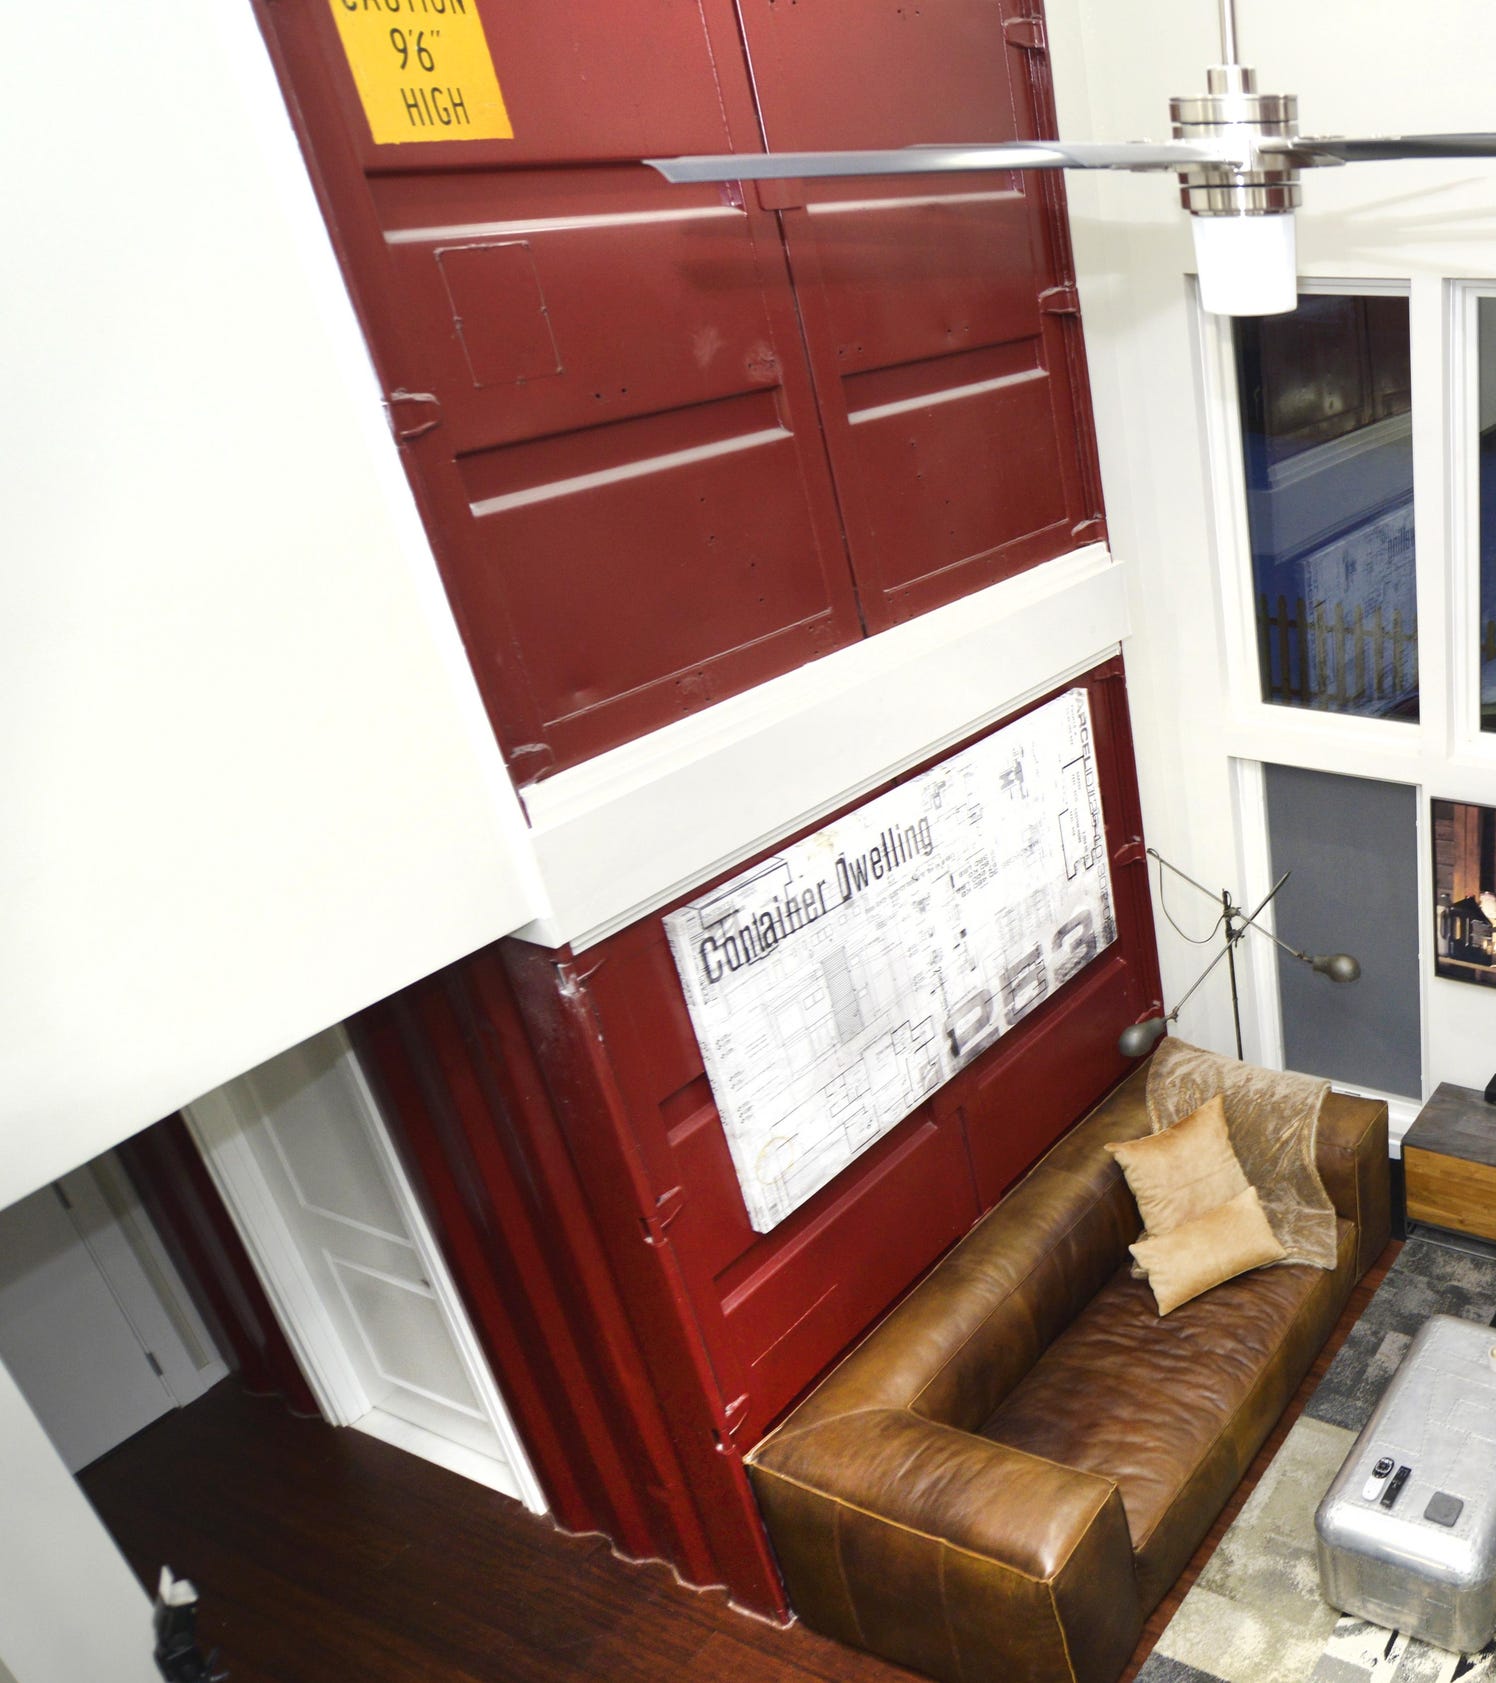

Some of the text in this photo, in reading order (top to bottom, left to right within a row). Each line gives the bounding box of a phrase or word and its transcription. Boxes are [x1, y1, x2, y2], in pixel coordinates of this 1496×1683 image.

[400, 87, 470, 126] HIGH
[700, 879, 826, 985] Container
[835, 816, 934, 901] Dwelling
